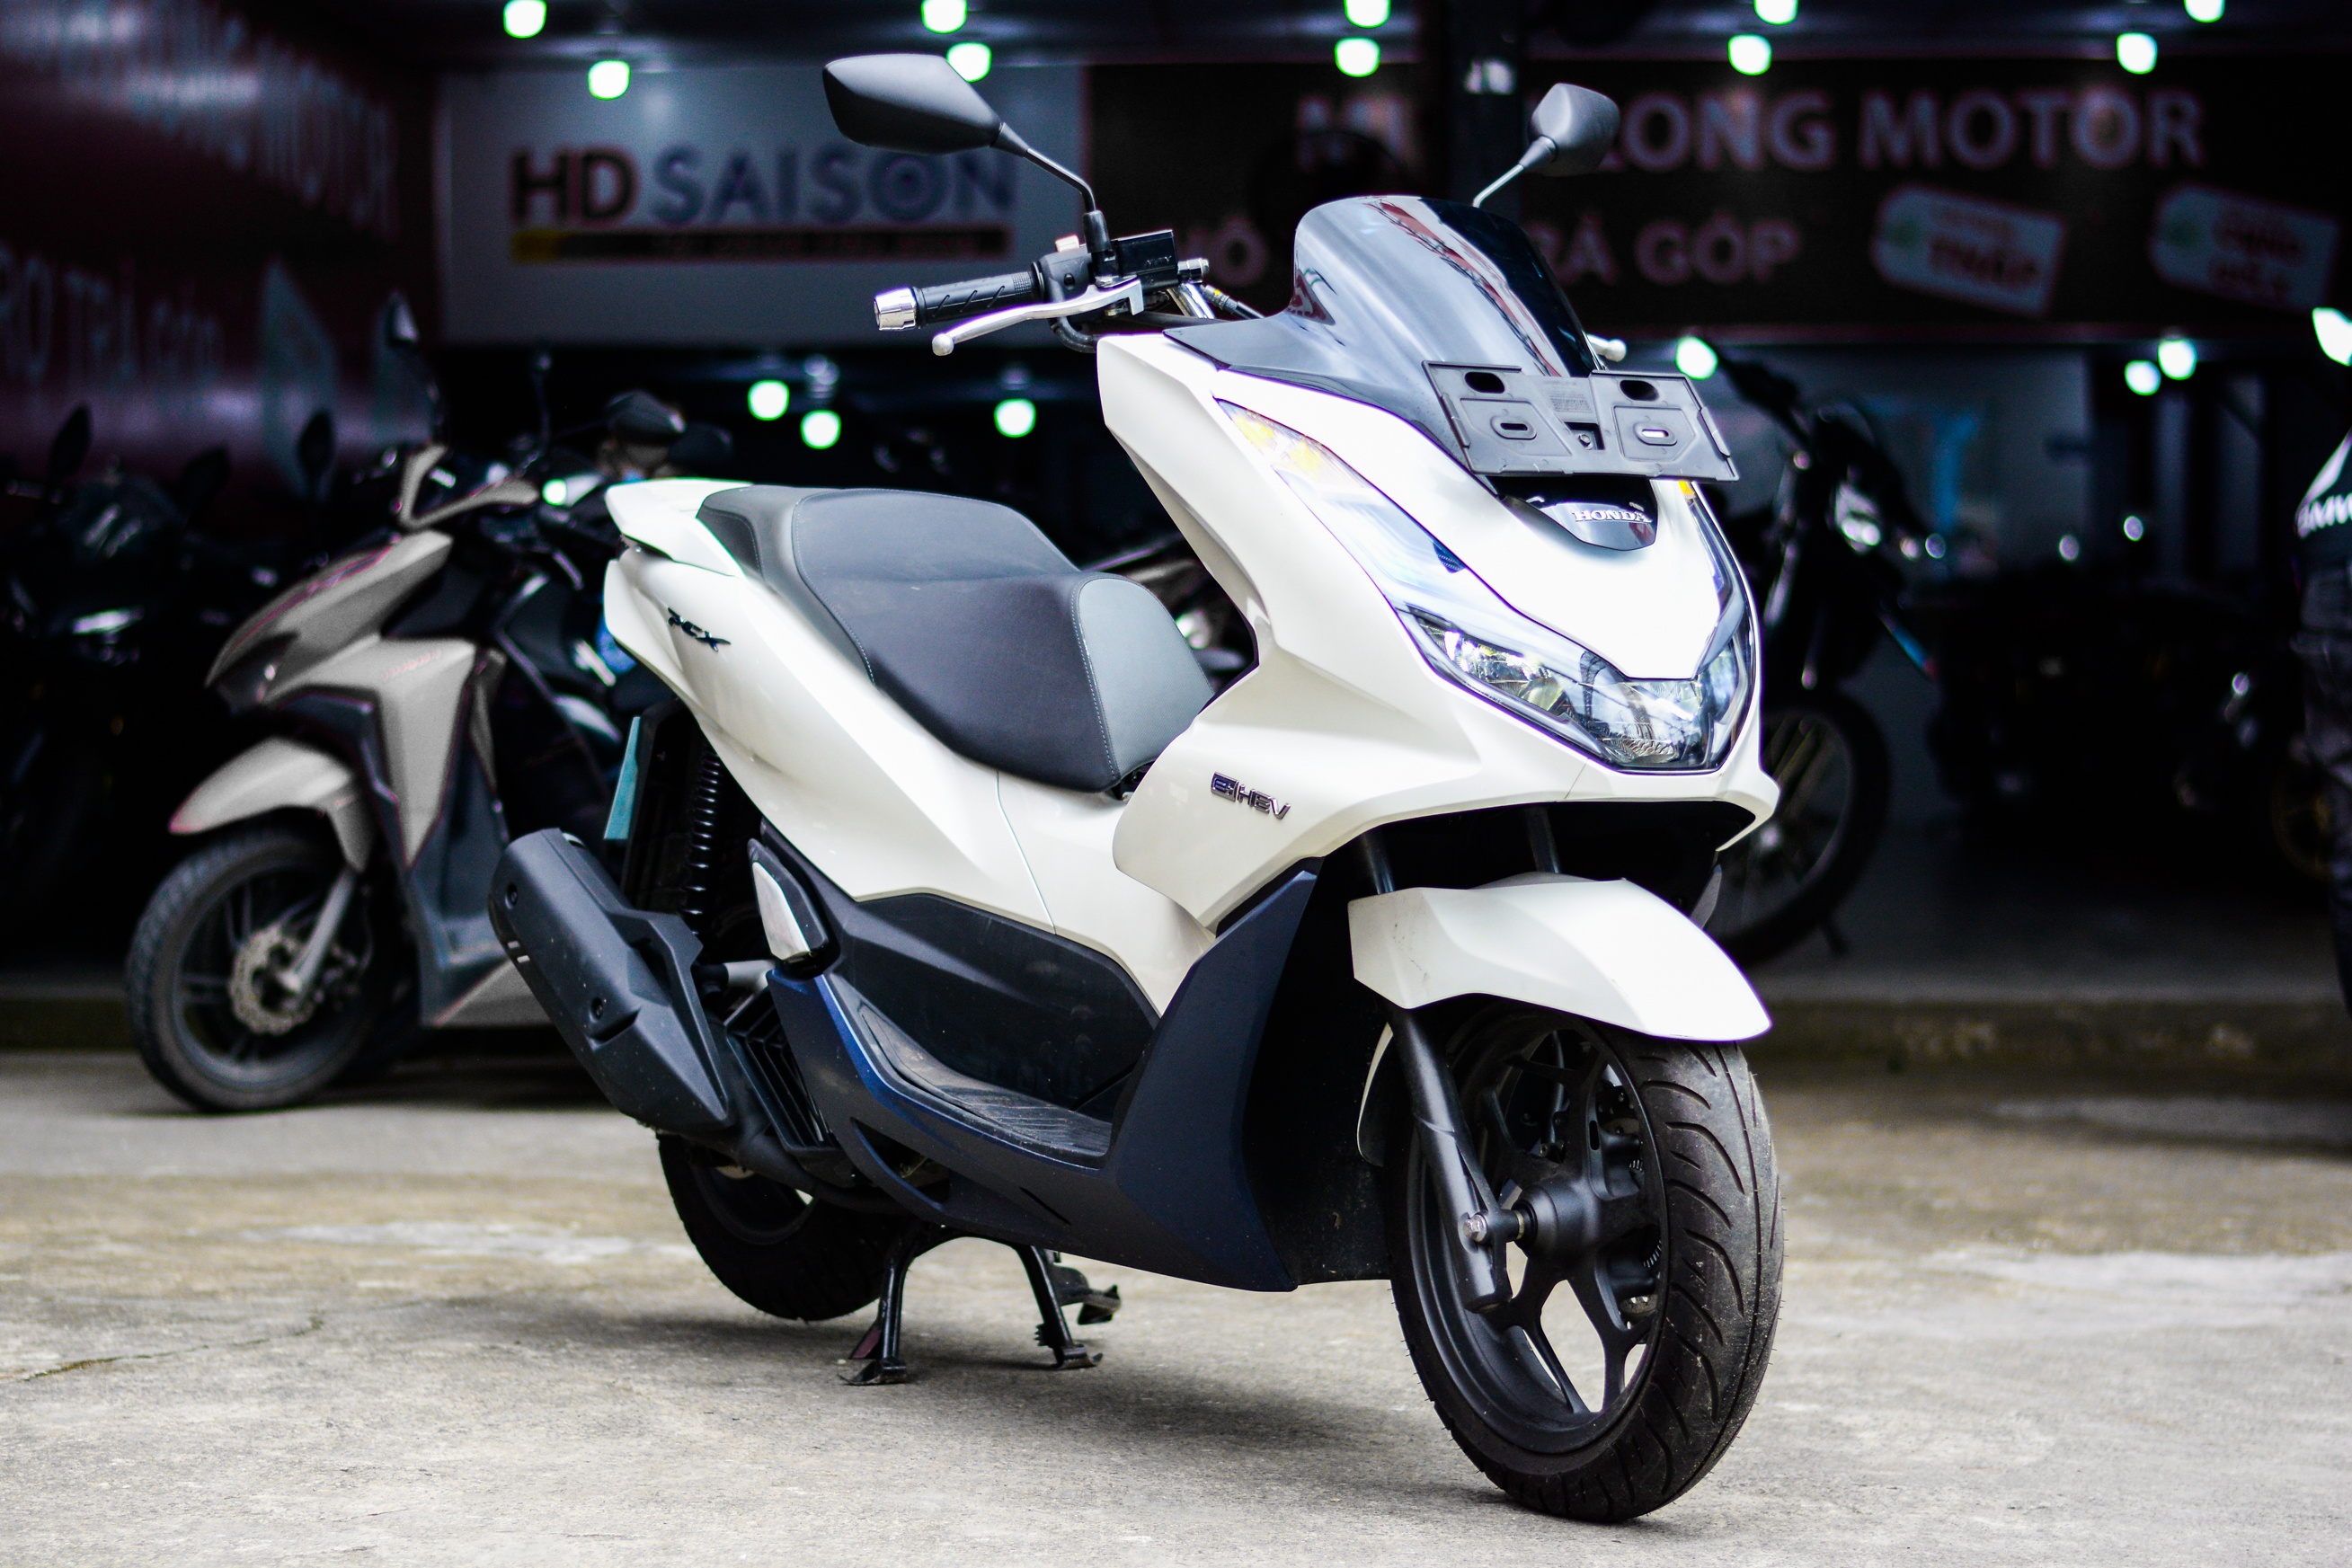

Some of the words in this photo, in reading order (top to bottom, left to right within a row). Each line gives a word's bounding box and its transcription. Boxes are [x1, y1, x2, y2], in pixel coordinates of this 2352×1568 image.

[1596, 88, 1838, 172] ONG
[1858, 87, 2209, 171] MOTOR
[650, 144, 1017, 226] SAISON
[1572, 509, 1653, 524] HONDA
